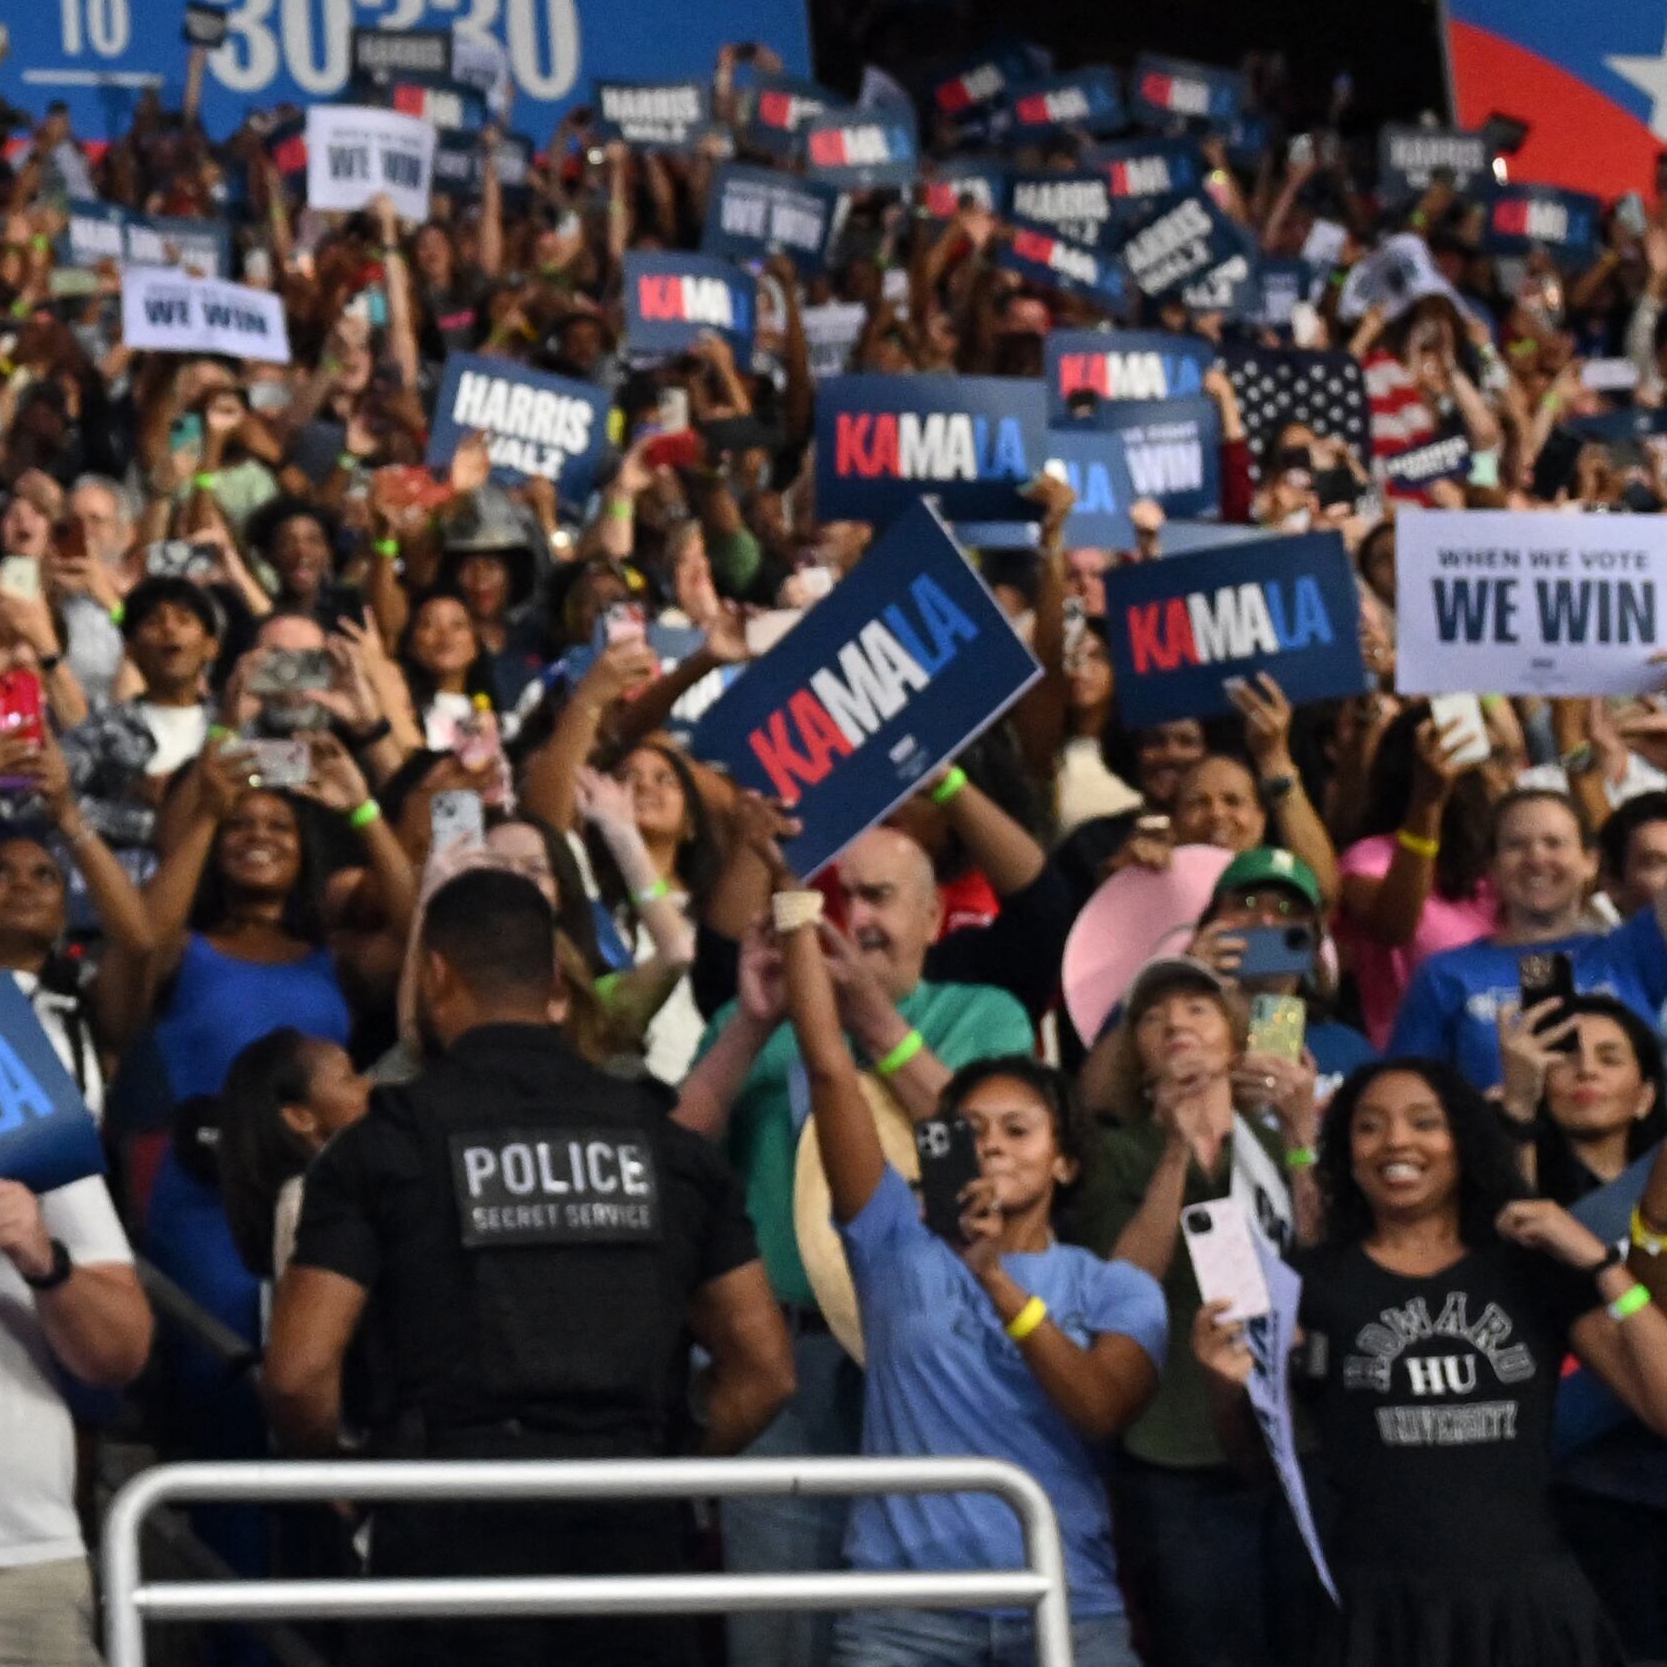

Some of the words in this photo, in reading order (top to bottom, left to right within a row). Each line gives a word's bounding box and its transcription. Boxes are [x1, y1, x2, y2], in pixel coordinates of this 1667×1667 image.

[601, 86, 700, 123] HARRIS
[327, 145, 370, 181] WE
[1013, 182, 1110, 223] HARRIS
[144, 298, 191, 327] WE
[203, 302, 269, 335] WIN
[1058, 351, 1202, 400] KAMALA
[453, 370, 595, 456] HARRIS
[836, 411, 1028, 482] KAMALA
[1126, 442, 1203, 493] WIN
[1438, 549, 1521, 570] WHEN
[1529, 549, 1572, 570] WE
[1579, 550, 1649, 570] VOTE
[1127, 574, 1335, 675] KAMALA
[1431, 579, 1519, 644] WE
[1535, 579, 1657, 644] WIN
[748, 572, 980, 809] KAMALA
[464, 1141, 650, 1199] POLICE
[471, 1204, 560, 1232] SECRET
[565, 1201, 651, 1230] SERVICE
[1343, 1290, 1538, 1395] HOWARD
[1404, 1353, 1477, 1396] HU
[1374, 1400, 1518, 1449] UNIVERSITY
